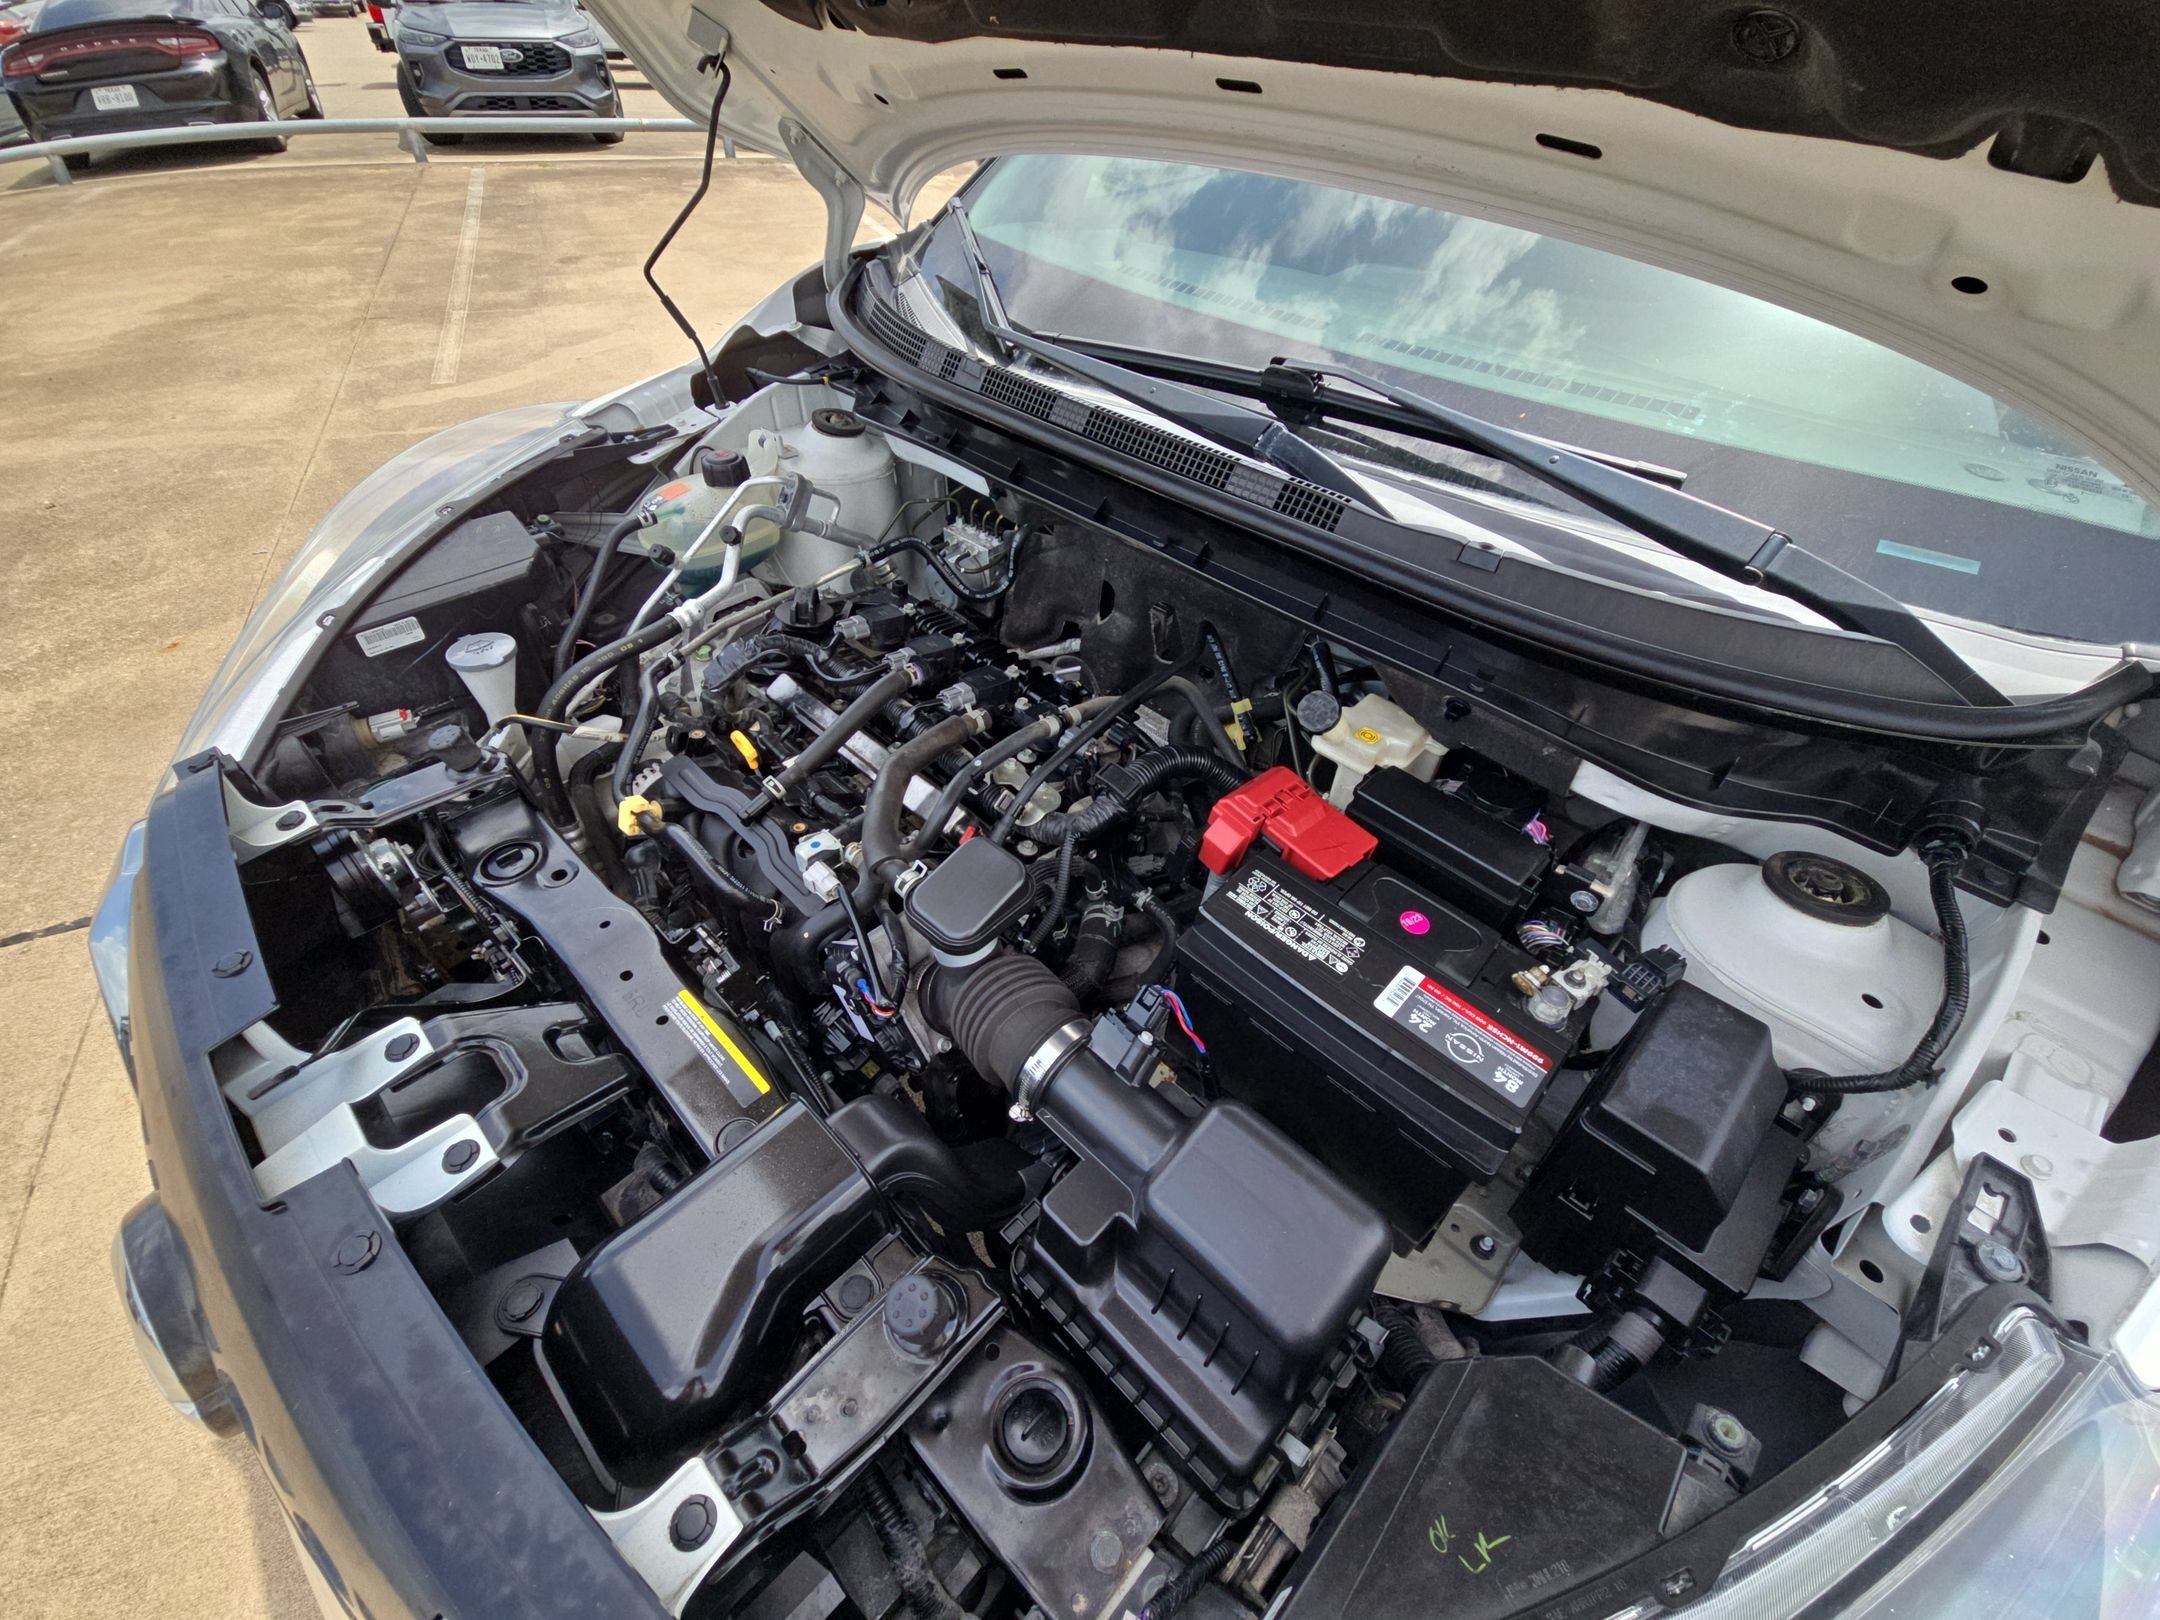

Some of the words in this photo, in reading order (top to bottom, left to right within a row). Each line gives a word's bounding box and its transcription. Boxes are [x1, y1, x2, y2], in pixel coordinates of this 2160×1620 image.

[2056, 464, 2098, 477] NISSAN
[1408, 1012, 1432, 1033] 24
[1412, 1008, 1437, 1026] MONTH
[1445, 1033, 1484, 1062] NISSAN
[1493, 1070, 1519, 1093] 84
[1497, 1066, 1524, 1085] MONTH
